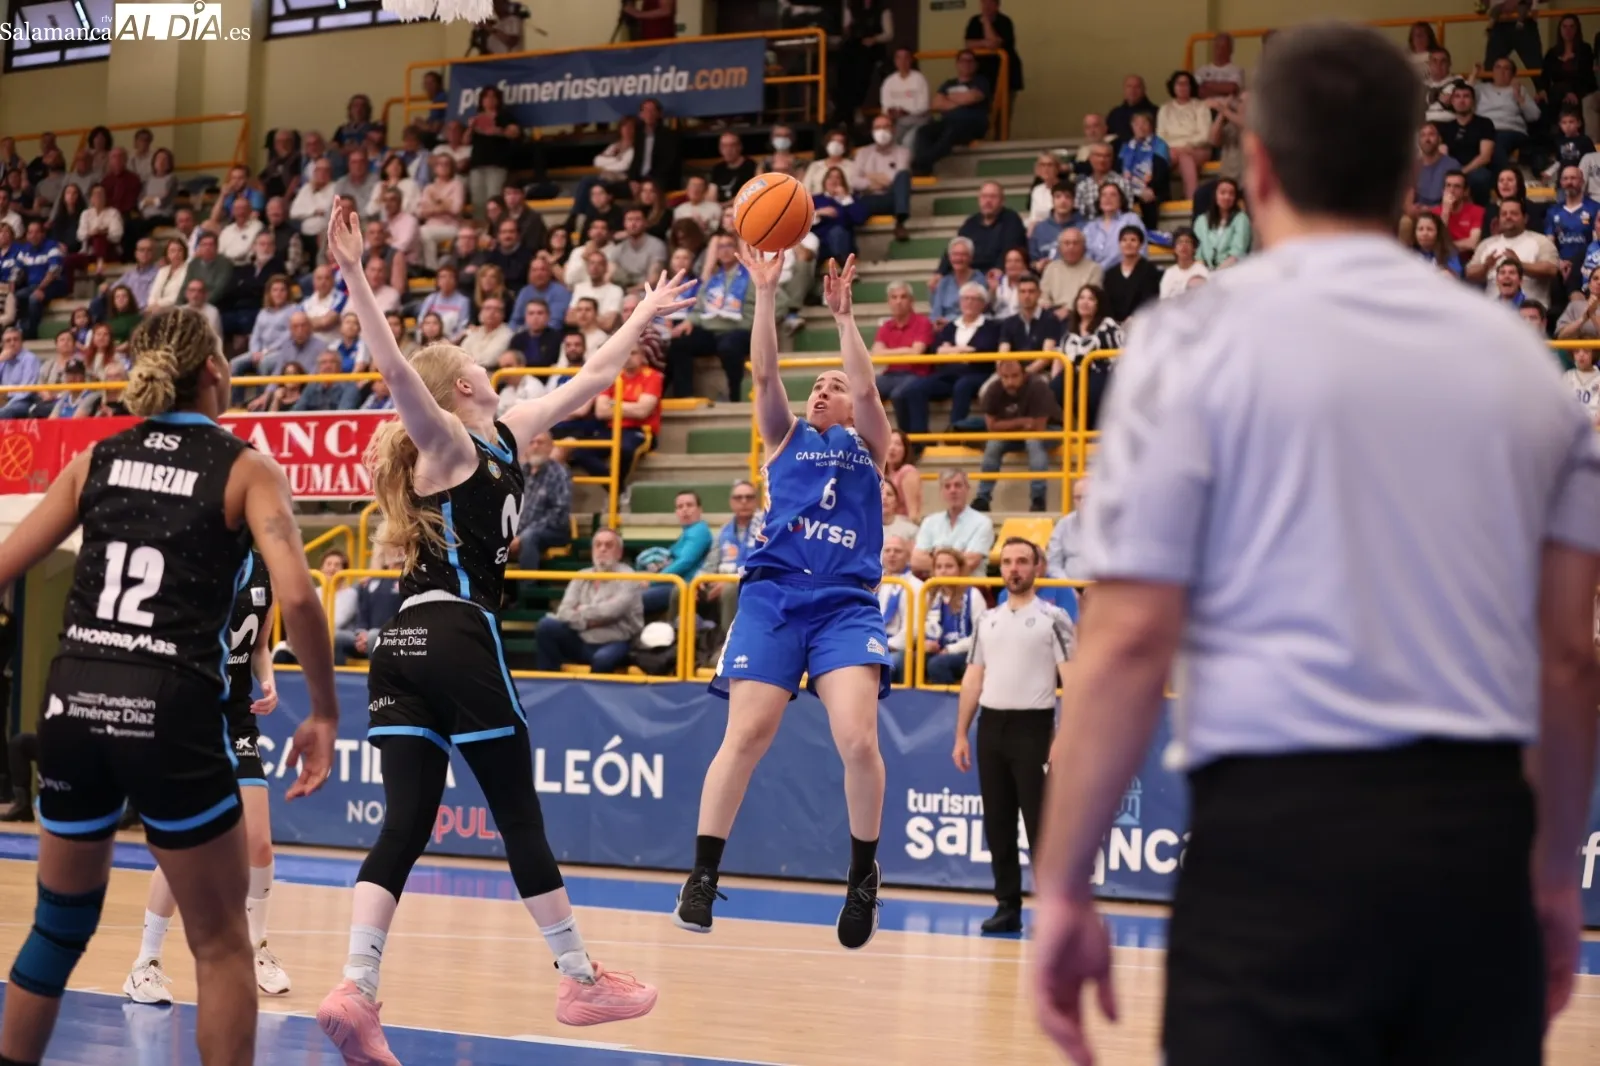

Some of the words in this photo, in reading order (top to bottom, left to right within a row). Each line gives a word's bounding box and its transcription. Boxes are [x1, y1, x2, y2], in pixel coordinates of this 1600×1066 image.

[143, 431, 182, 451] as
[107, 459, 199, 497] BANASZAK
[819, 477, 838, 511] 6
[96, 541, 165, 627] 12
[535, 735, 664, 799] LEÓN
